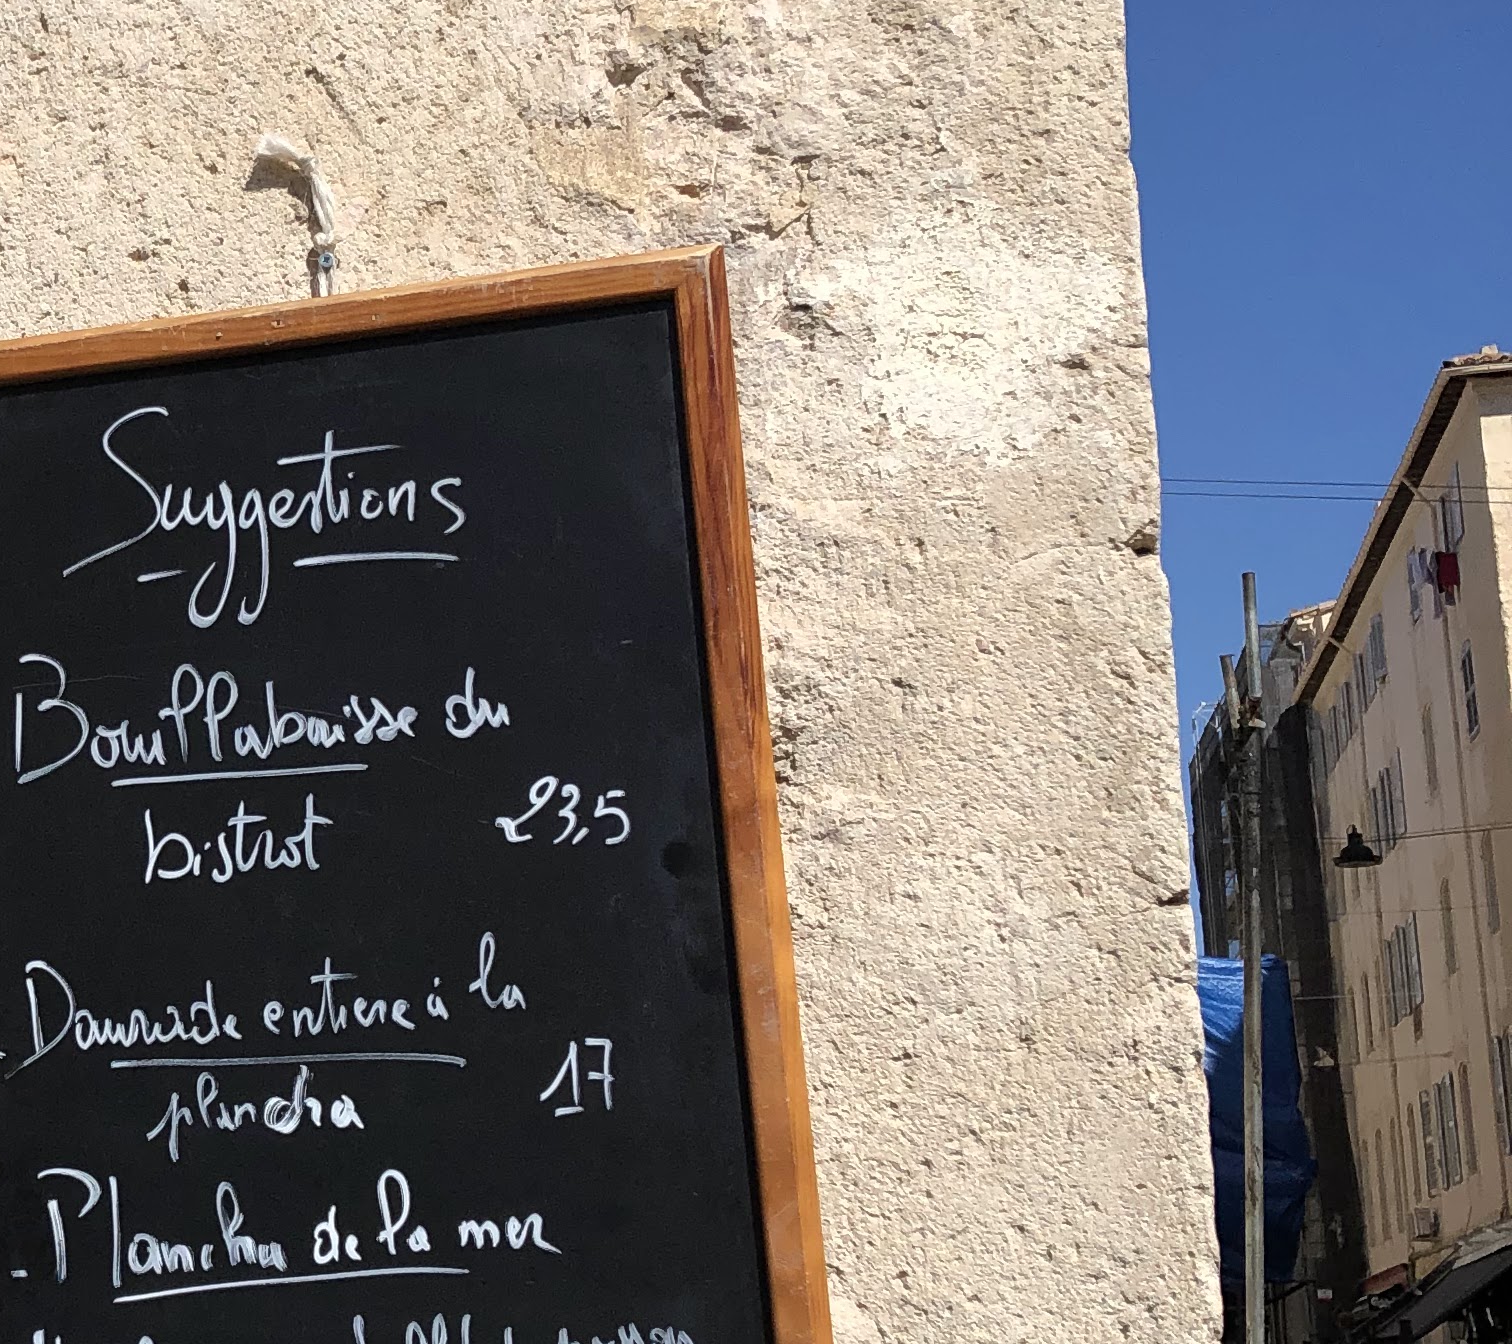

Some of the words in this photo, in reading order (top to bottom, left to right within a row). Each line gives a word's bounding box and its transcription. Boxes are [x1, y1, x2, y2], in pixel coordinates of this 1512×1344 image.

[63, 406, 467, 627] Suggestions
[445, 666, 511, 739] du
[144, 792, 334, 885] bistrot
[494, 775, 630, 846] 23,5
[468, 931, 527, 1011] la
[539, 1038, 614, 1116] 17
[36, 1168, 287, 1288] Plancha
[313, 1206, 362, 1266] de
[377, 1168, 430, 1255] la
